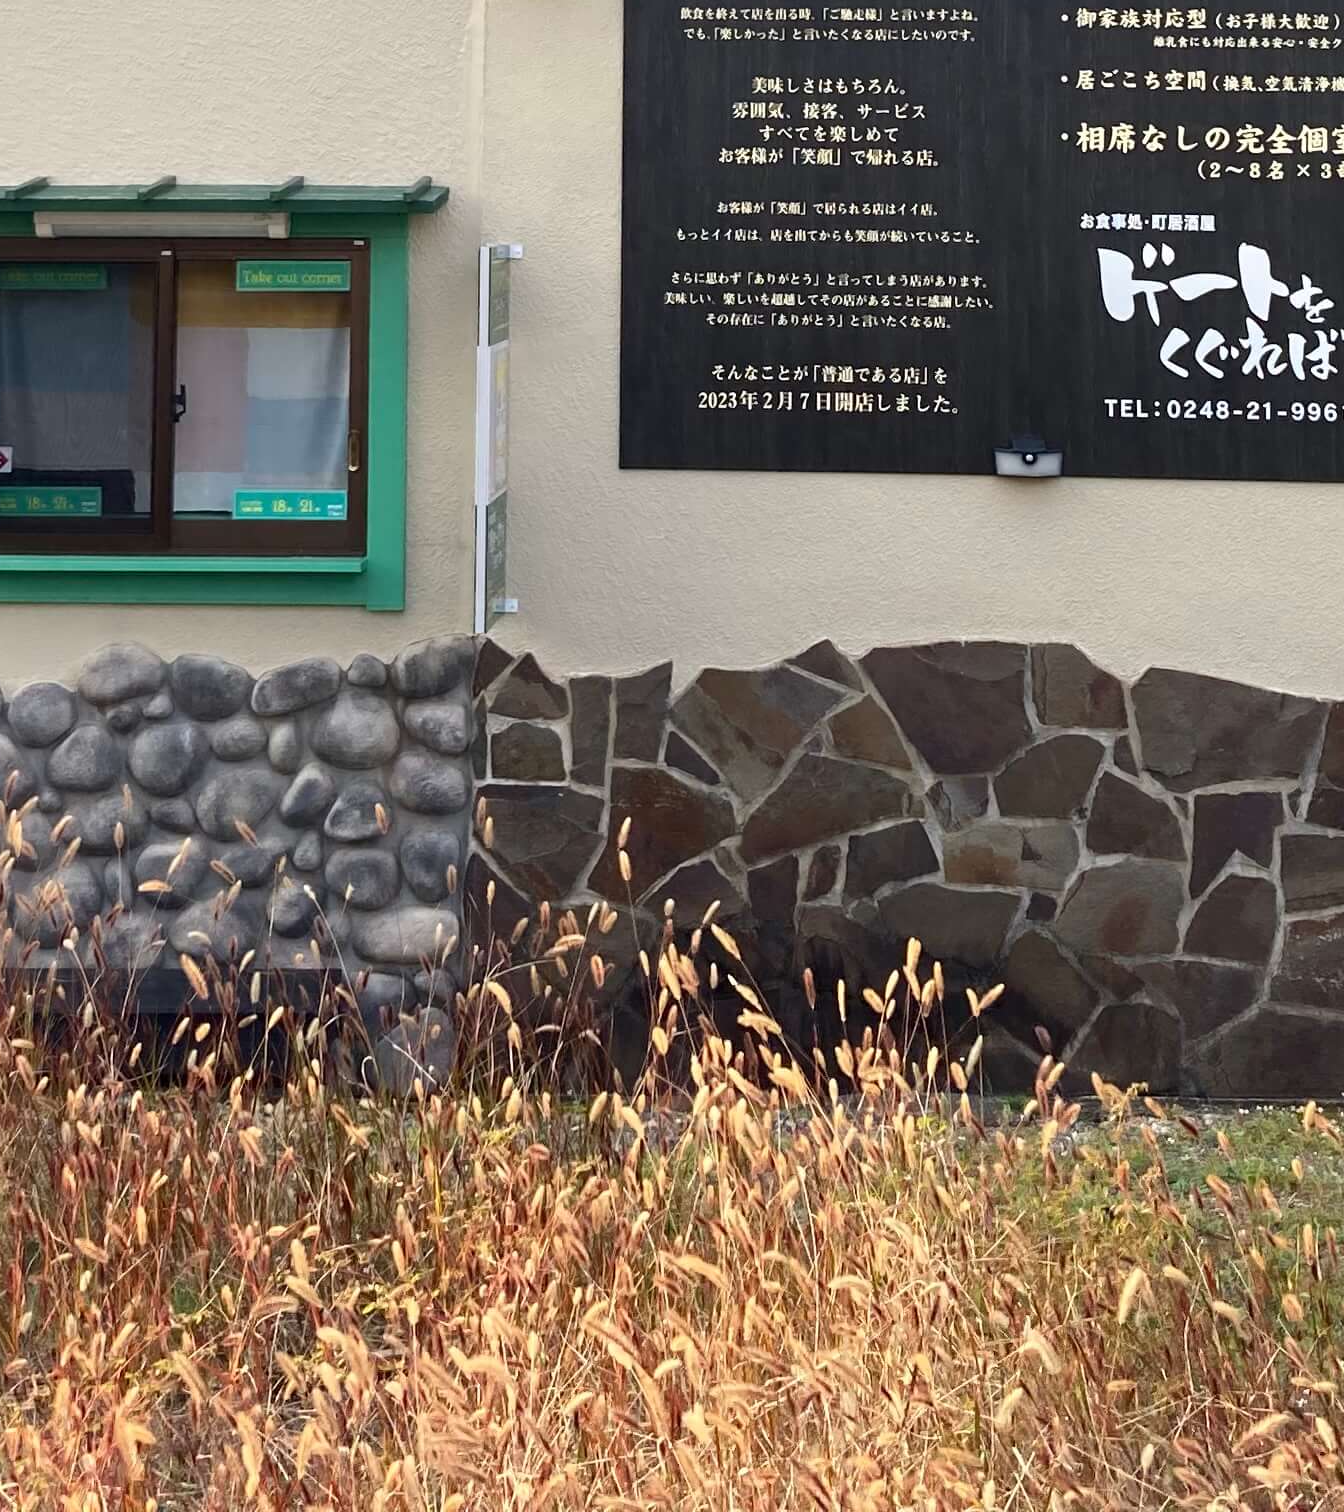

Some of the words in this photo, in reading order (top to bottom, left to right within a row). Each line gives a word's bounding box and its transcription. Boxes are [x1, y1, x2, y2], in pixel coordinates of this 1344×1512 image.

[752, 76, 906, 95] 美味しさはもちろん。
[759, 124, 899, 143] すべてを楽しめて
[1080, 212, 1216, 232] お食事処・町居酒屋
[243, 270, 273, 284] Take
[711, 364, 947, 385] そんなことが「普通である店」を
[698, 390, 958, 414] 2023年2月7日開店しました。
